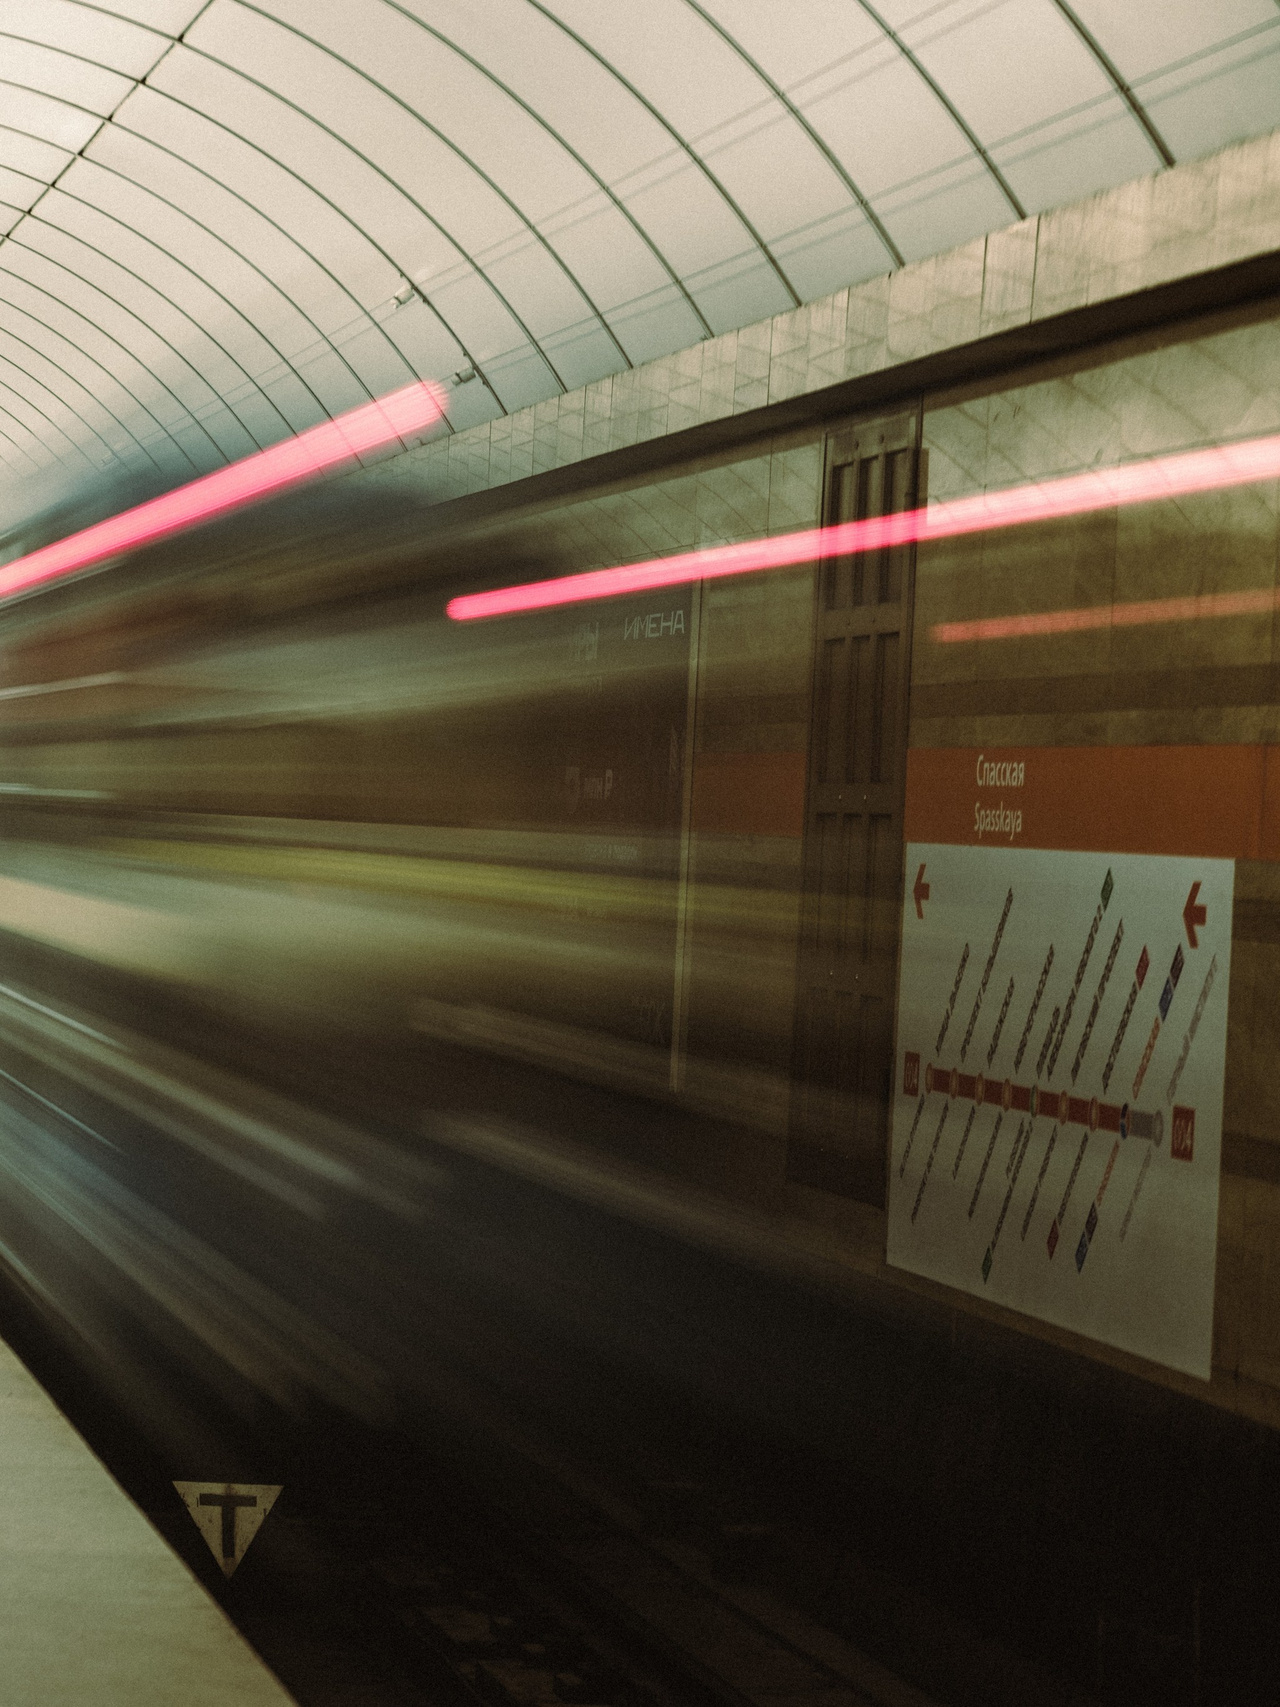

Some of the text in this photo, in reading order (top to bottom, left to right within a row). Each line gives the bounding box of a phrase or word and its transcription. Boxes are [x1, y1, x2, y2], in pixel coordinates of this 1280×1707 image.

[623, 609, 685, 641] ИМЕНА
[976, 754, 1025, 787] Спасская
[974, 801, 1022, 841] Spasskaya
